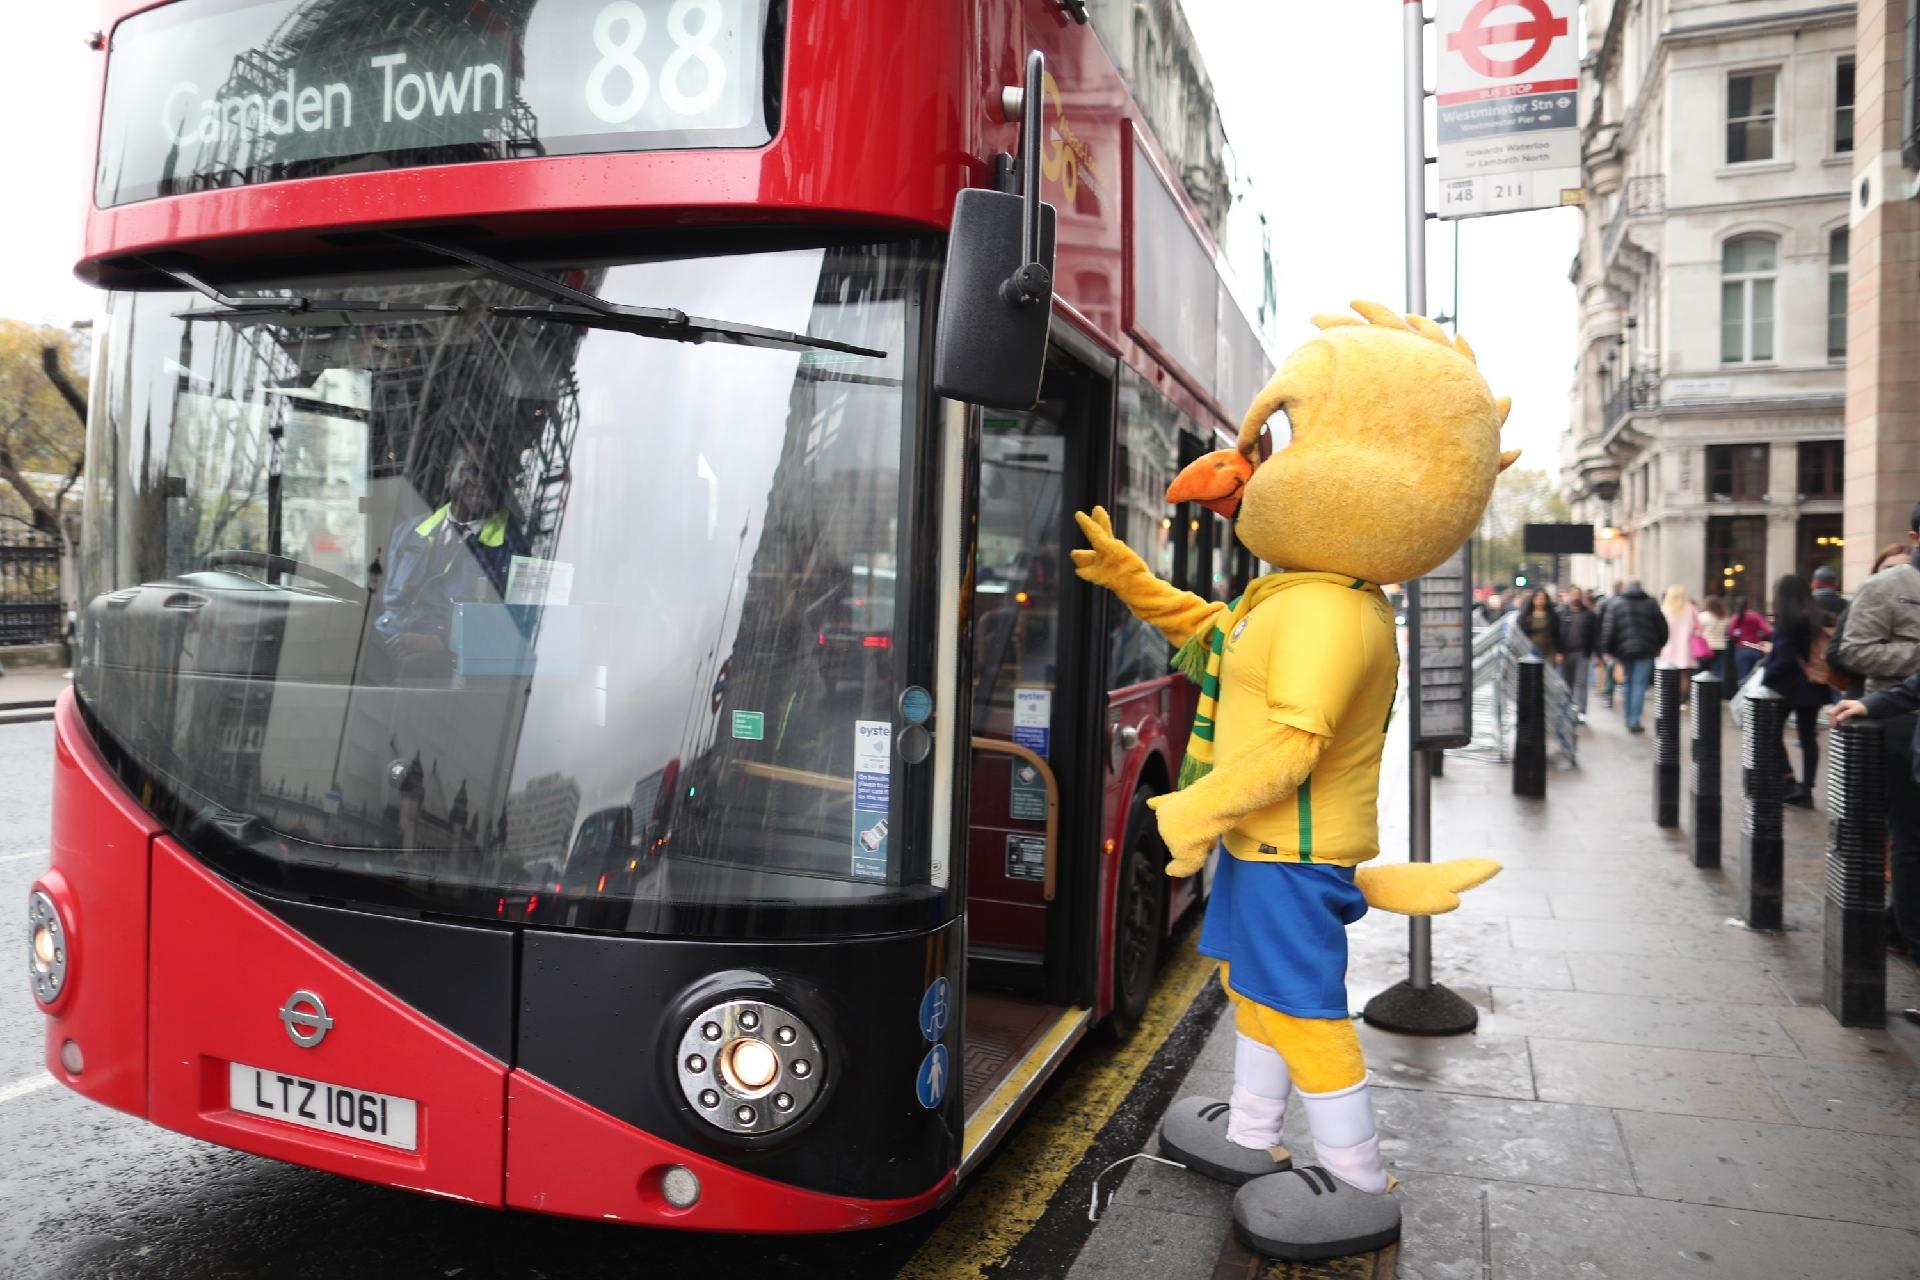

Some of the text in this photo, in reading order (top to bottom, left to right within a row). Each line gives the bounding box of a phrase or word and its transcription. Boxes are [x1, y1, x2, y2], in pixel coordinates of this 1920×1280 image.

[585, 0, 728, 124] 88
[1481, 83, 1533, 98] BUS STOP
[162, 52, 504, 147] Camden Town
[1442, 99, 1554, 122] Westminster Stn
[1506, 141, 1550, 153] Waterloo
[1478, 155, 1520, 167] Lambeth
[1521, 152, 1550, 163] North
[1447, 188, 1473, 204] 148
[1495, 183, 1523, 198] 211
[859, 726, 892, 737] oyste
